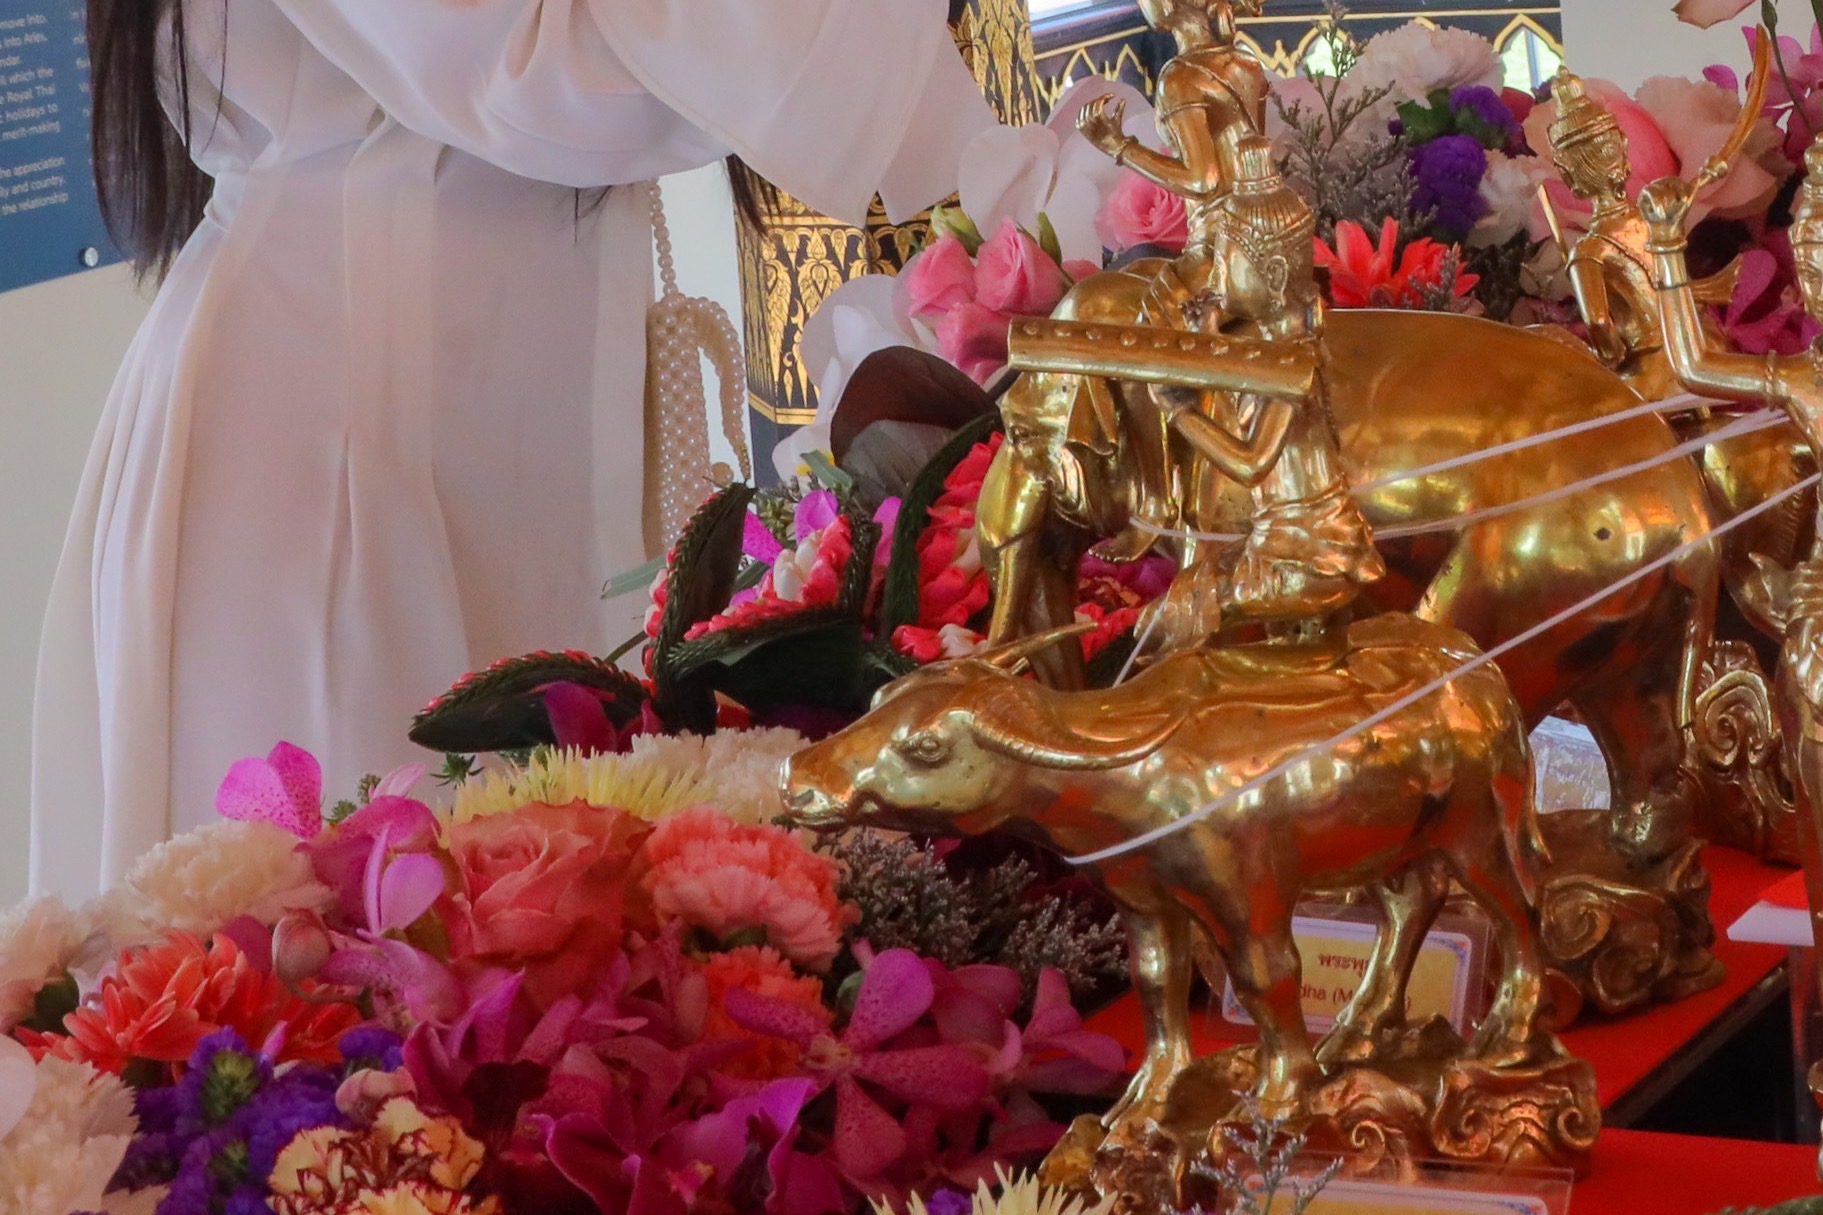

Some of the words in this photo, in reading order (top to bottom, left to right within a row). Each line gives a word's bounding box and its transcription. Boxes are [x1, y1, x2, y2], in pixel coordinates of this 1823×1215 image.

[37, 67, 53, 79] the
[7, 88, 32, 103] Royal
[35, 83, 56, 96] Thai
[6, 106, 45, 122] holidays
[48, 103, 58, 114] to
[13, 157, 64, 177] appreciation
[11, 182, 29, 195] and
[2, 202, 17, 215] the
[19, 192, 69, 211] relationship
